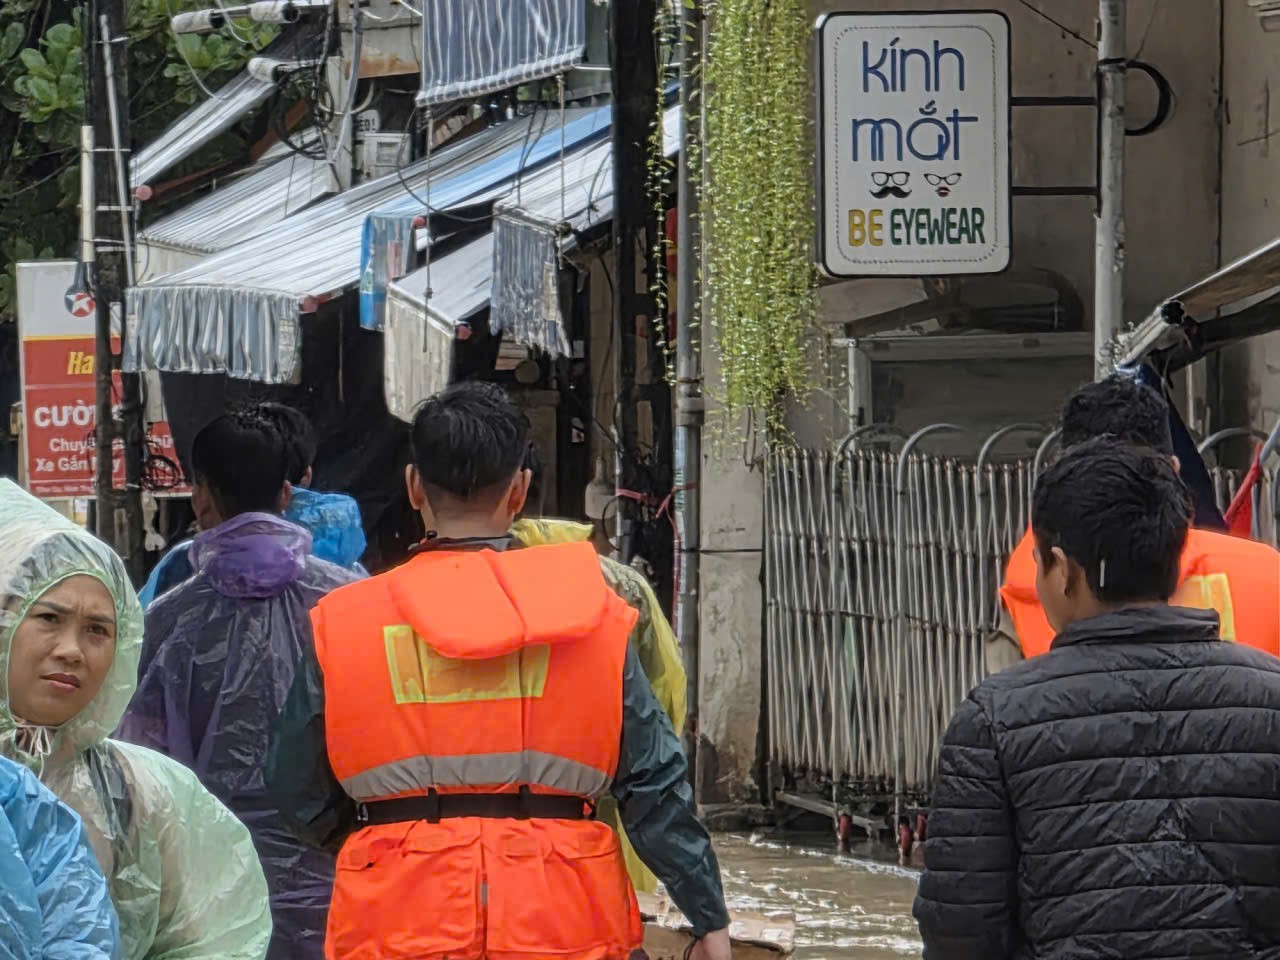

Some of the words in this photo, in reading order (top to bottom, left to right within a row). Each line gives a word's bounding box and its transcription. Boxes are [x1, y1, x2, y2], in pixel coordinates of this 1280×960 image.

[862, 36, 965, 93] kính
[851, 100, 978, 162] mắt
[848, 208, 884, 247] BE
[890, 207, 986, 246] EYEWEAR
